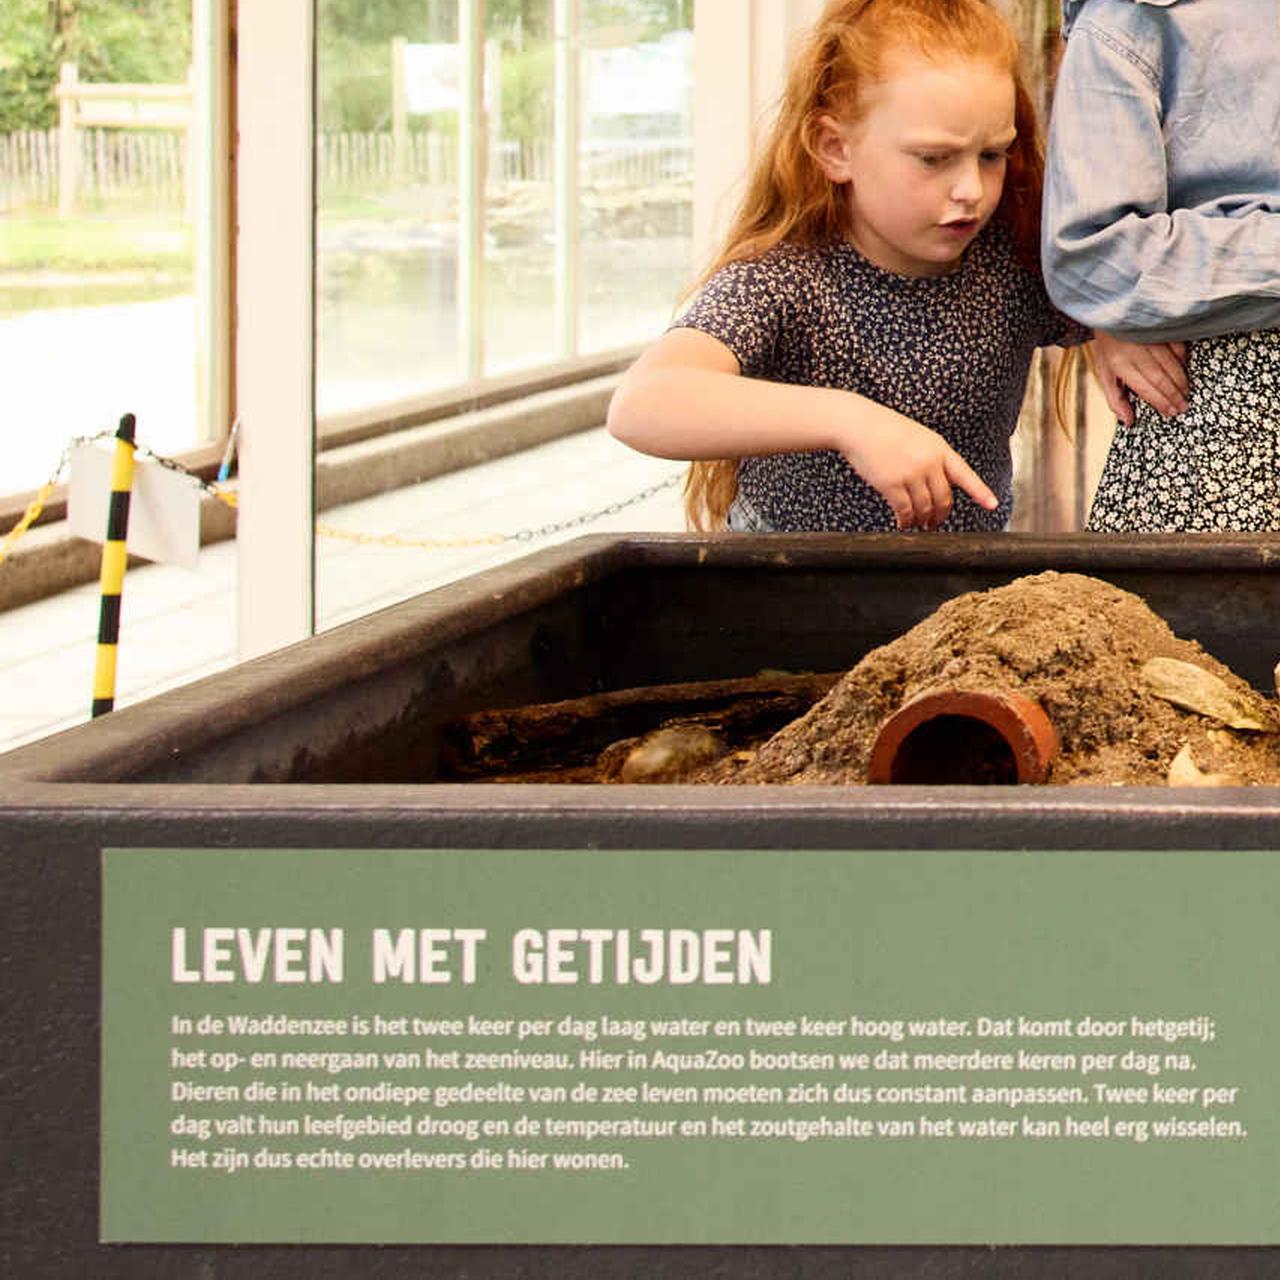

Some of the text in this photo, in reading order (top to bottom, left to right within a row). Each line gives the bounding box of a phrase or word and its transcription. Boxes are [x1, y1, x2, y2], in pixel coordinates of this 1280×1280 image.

[172, 927, 771, 984] LEVEN MET GETIJDEN
[172, 1016, 193, 1034] In
[197, 1014, 224, 1035] de
[227, 1015, 348, 1036] Waddenzee
[352, 1015, 370, 1036] is
[374, 1015, 409, 1036] het
[412, 1018, 464, 1036] twee
[468, 1015, 515, 1036] keer
[517, 1020, 554, 1040] per
[557, 1015, 598, 1041] dag
[601, 1015, 647, 1042] laag
[650, 1018, 711, 1036] water
[713, 1020, 741, 1036] en
[745, 1018, 797, 1037] twee
[800, 1016, 847, 1037] keer
[850, 1016, 905, 1042] hoog
[907, 1018, 972, 1037] water.
[977, 1017, 1014, 1037] Dat
[1017, 1016, 1073, 1037] komt
[1076, 1016, 1128, 1037] door
[171, 1047, 1197, 1075] het op- en neergaan van het zeeniveau. Hier in AquaZoo bootsen we dat meerdere keren per dag na.
[172, 1081, 1239, 1108] Dieren die in het ondiepe gedeelte van de zee leven moeten zich dus constant aanpassen. Twee keer per
[170, 1114, 1248, 1142] dag valt hun leefgebied droog en de temperatuur en het zoutgehalte van het water kan heel erg wisselen.
[171, 1147, 630, 1173] Het zijn dus echte overlevers die hier wonen.
